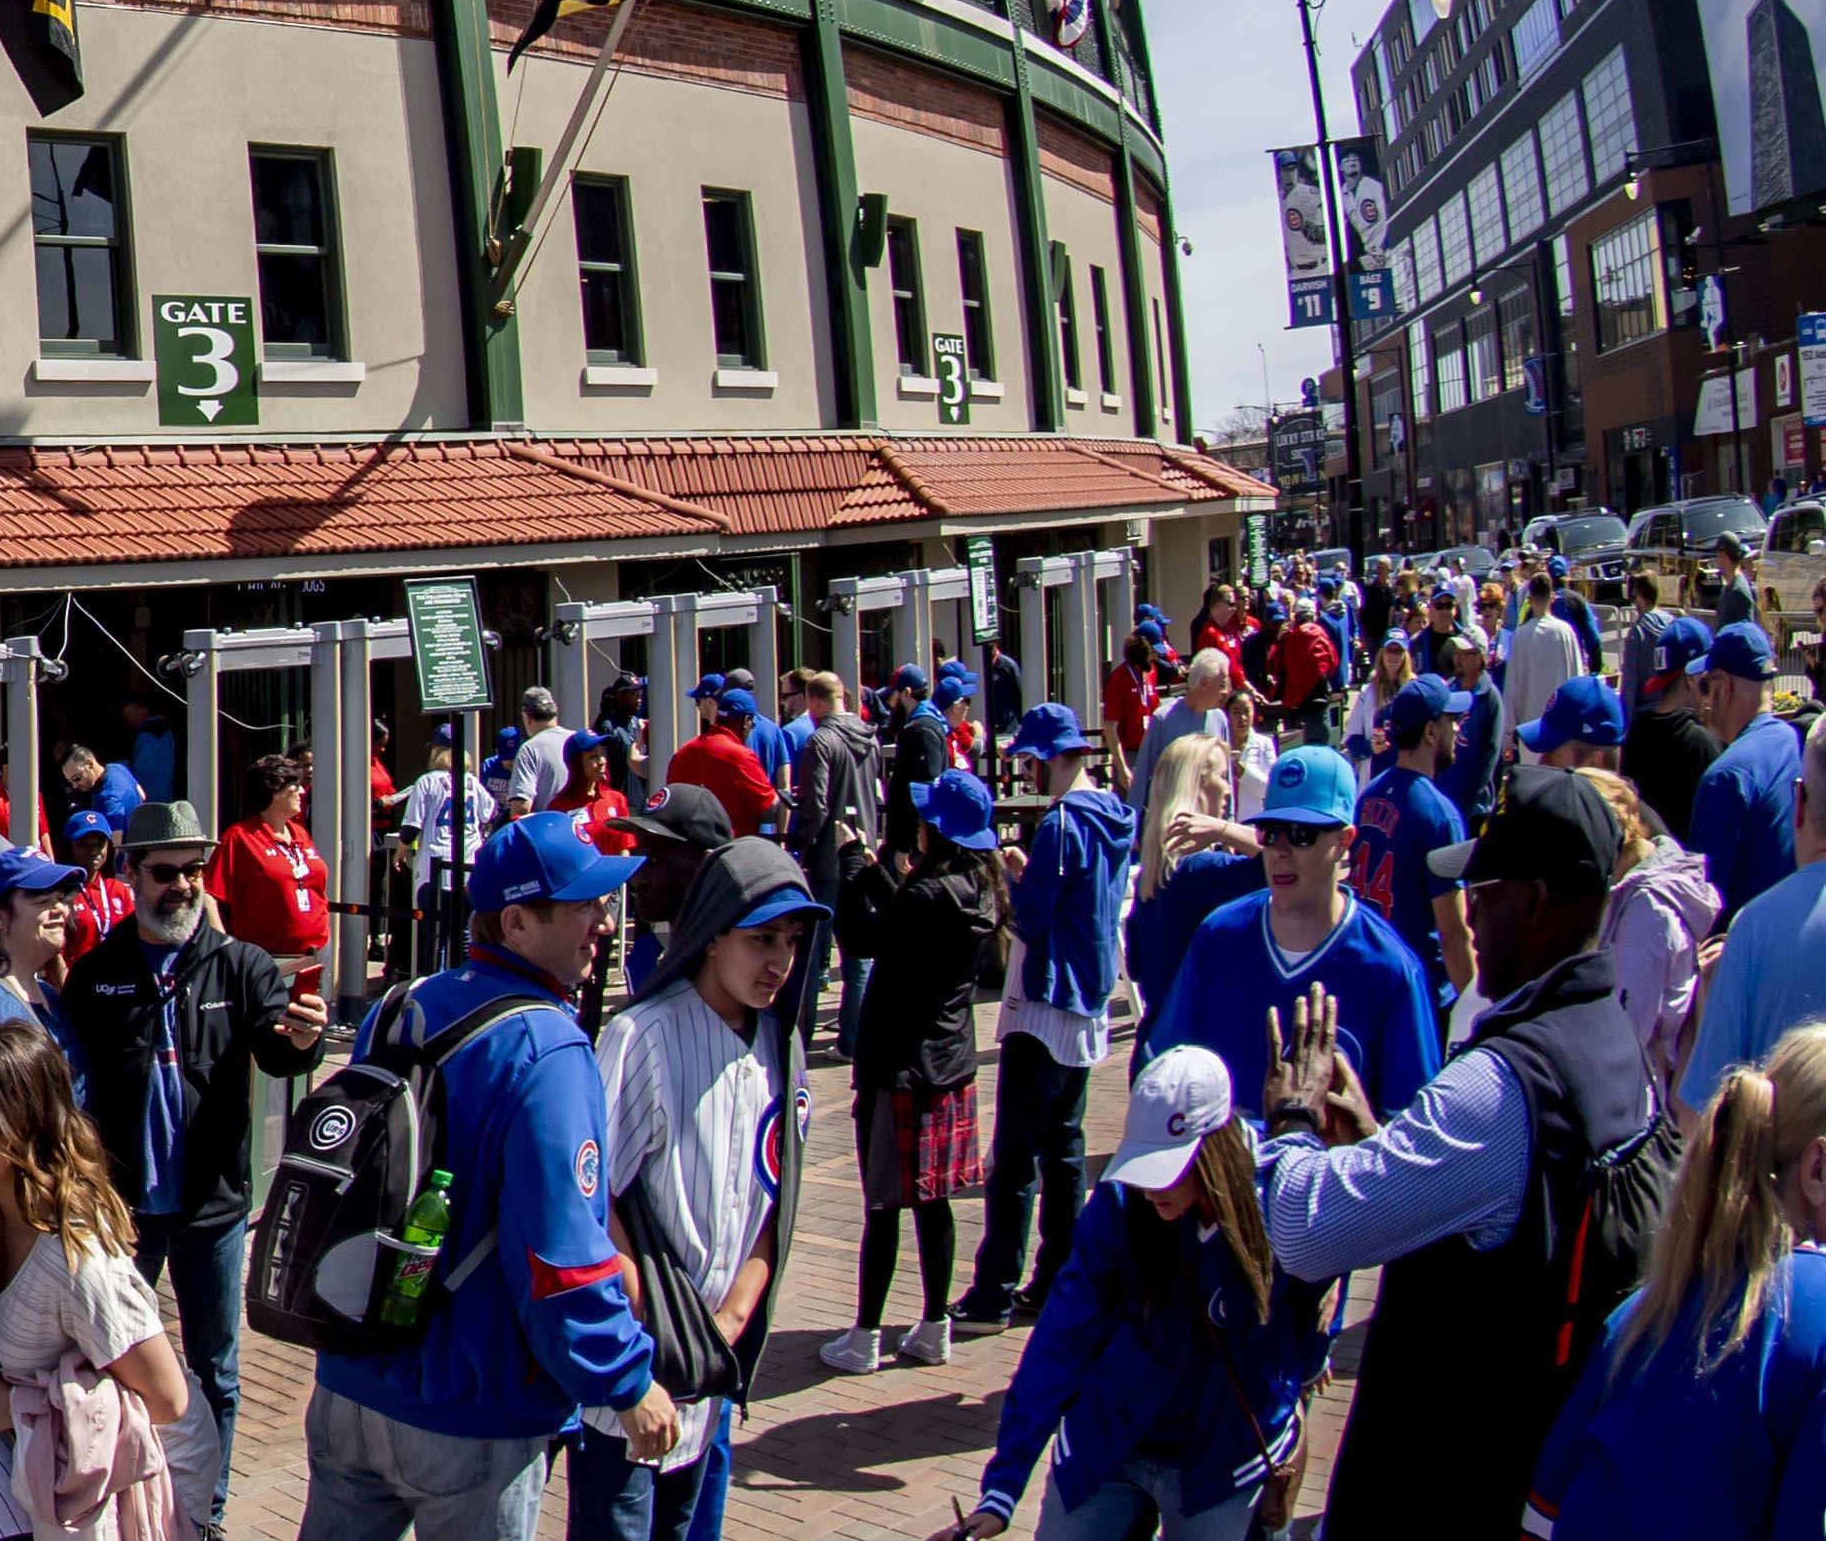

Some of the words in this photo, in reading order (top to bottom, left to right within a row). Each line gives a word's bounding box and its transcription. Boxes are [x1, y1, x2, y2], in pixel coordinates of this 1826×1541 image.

[159, 301, 247, 326] GATE
[176, 326, 239, 396] 3
[934, 336, 964, 356] GATE
[940, 355, 963, 406] 3
